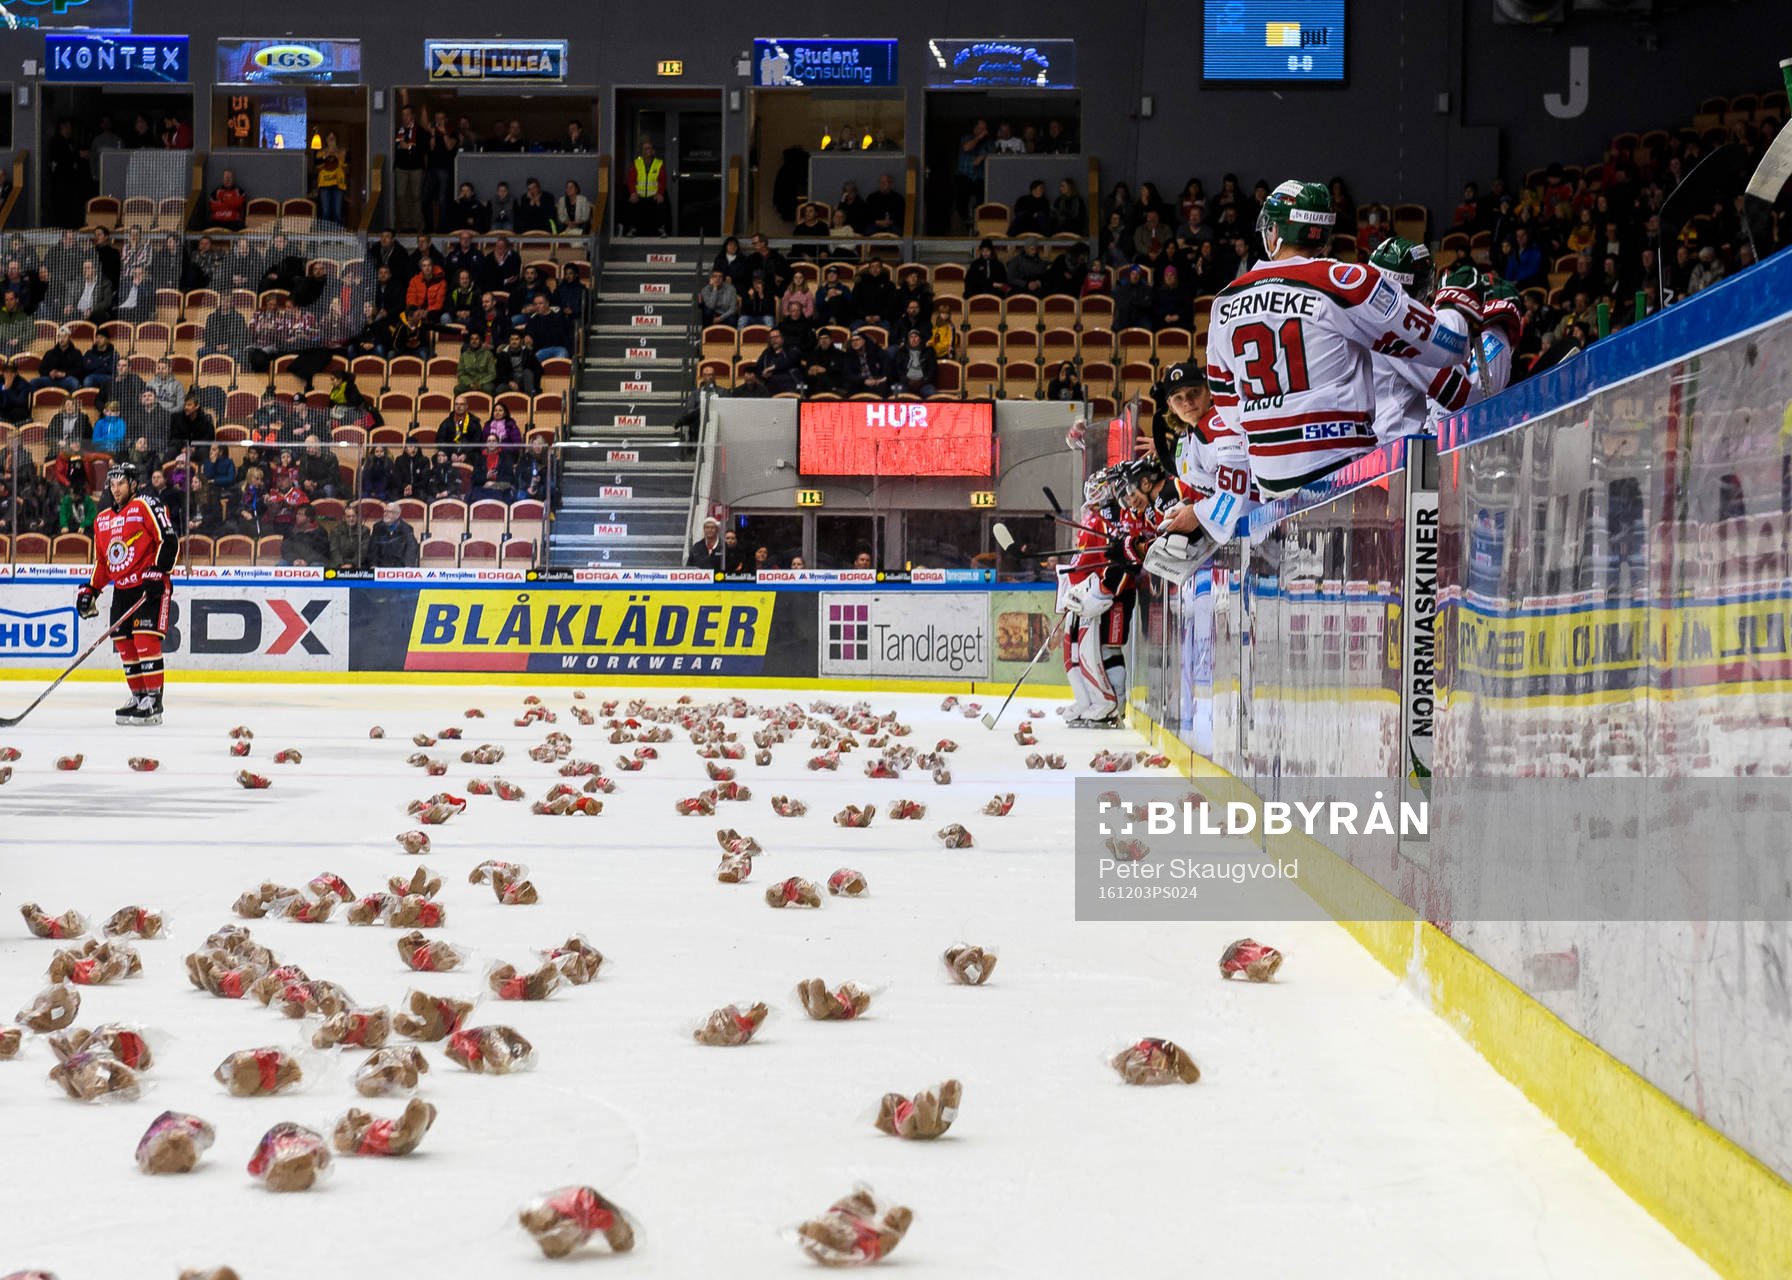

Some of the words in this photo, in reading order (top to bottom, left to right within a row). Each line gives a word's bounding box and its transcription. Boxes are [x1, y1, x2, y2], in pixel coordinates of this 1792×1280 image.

[55, 46, 179, 70] KONTEX
[266, 53, 310, 66] LGS
[491, 51, 552, 72] LULEÅ
[794, 48, 859, 64] Student
[793, 63, 872, 83] Consulting
[1544, 46, 1589, 119] J
[1219, 291, 1315, 326] SERNEKE
[1403, 304, 1438, 343] 31
[1231, 316, 1310, 400] 31
[629, 404, 635, 414] 7
[866, 404, 928, 427] HUR
[1305, 422, 1353, 440] SKF
[1218, 464, 1247, 494] 50
[609, 512, 616, 521] 4
[602, 550, 610, 560] 3
[274, 570, 320, 578] BORGA
[377, 571, 422, 579] BORGA
[478, 572, 522, 580] BORGA
[576, 572, 618, 580] BORGA
[670, 572, 710, 581] BORGA
[758, 573, 796, 581] BORGA
[839, 573, 874, 581] BORGA
[913, 572, 943, 581] BORGA
[420, 593, 758, 648] BLÅKLÄDER
[1412, 508, 1438, 737] NORRMASKINER
[874, 620, 984, 671] Tandlaget
[561, 655, 723, 671] WORKWEAR
